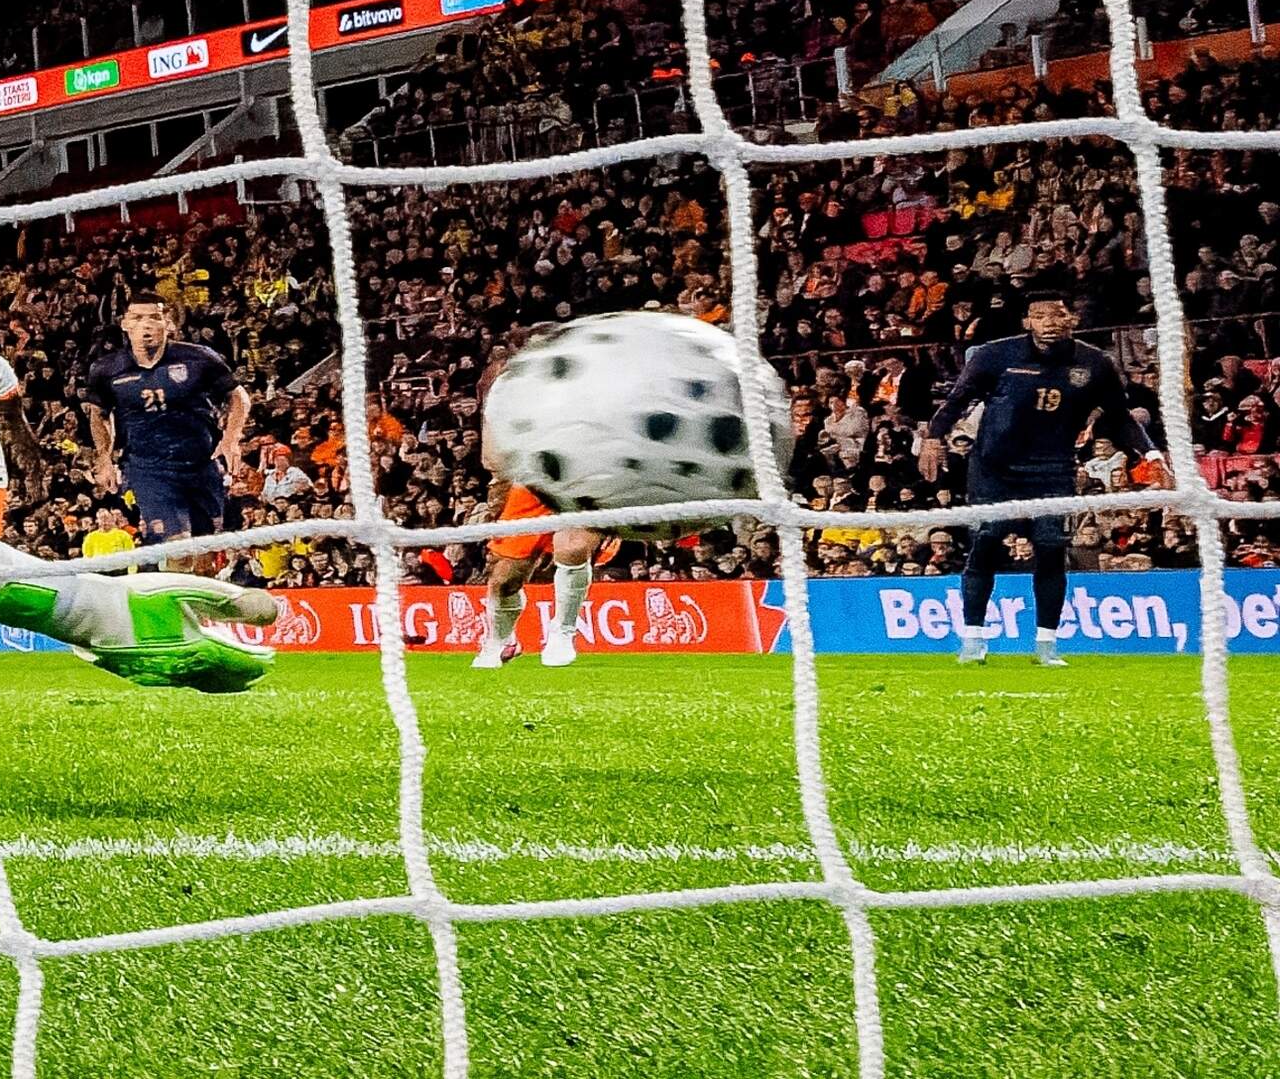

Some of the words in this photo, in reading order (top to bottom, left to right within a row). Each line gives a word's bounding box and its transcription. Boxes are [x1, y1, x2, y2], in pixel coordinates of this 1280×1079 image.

[152, 52, 182, 74] ING
[3, 81, 30, 96] STAATS
[87, 69, 110, 87] kpn
[1037, 388, 1061, 412] 19
[879, 589, 1026, 639] Beter
[1056, 586, 1187, 652] eten,
